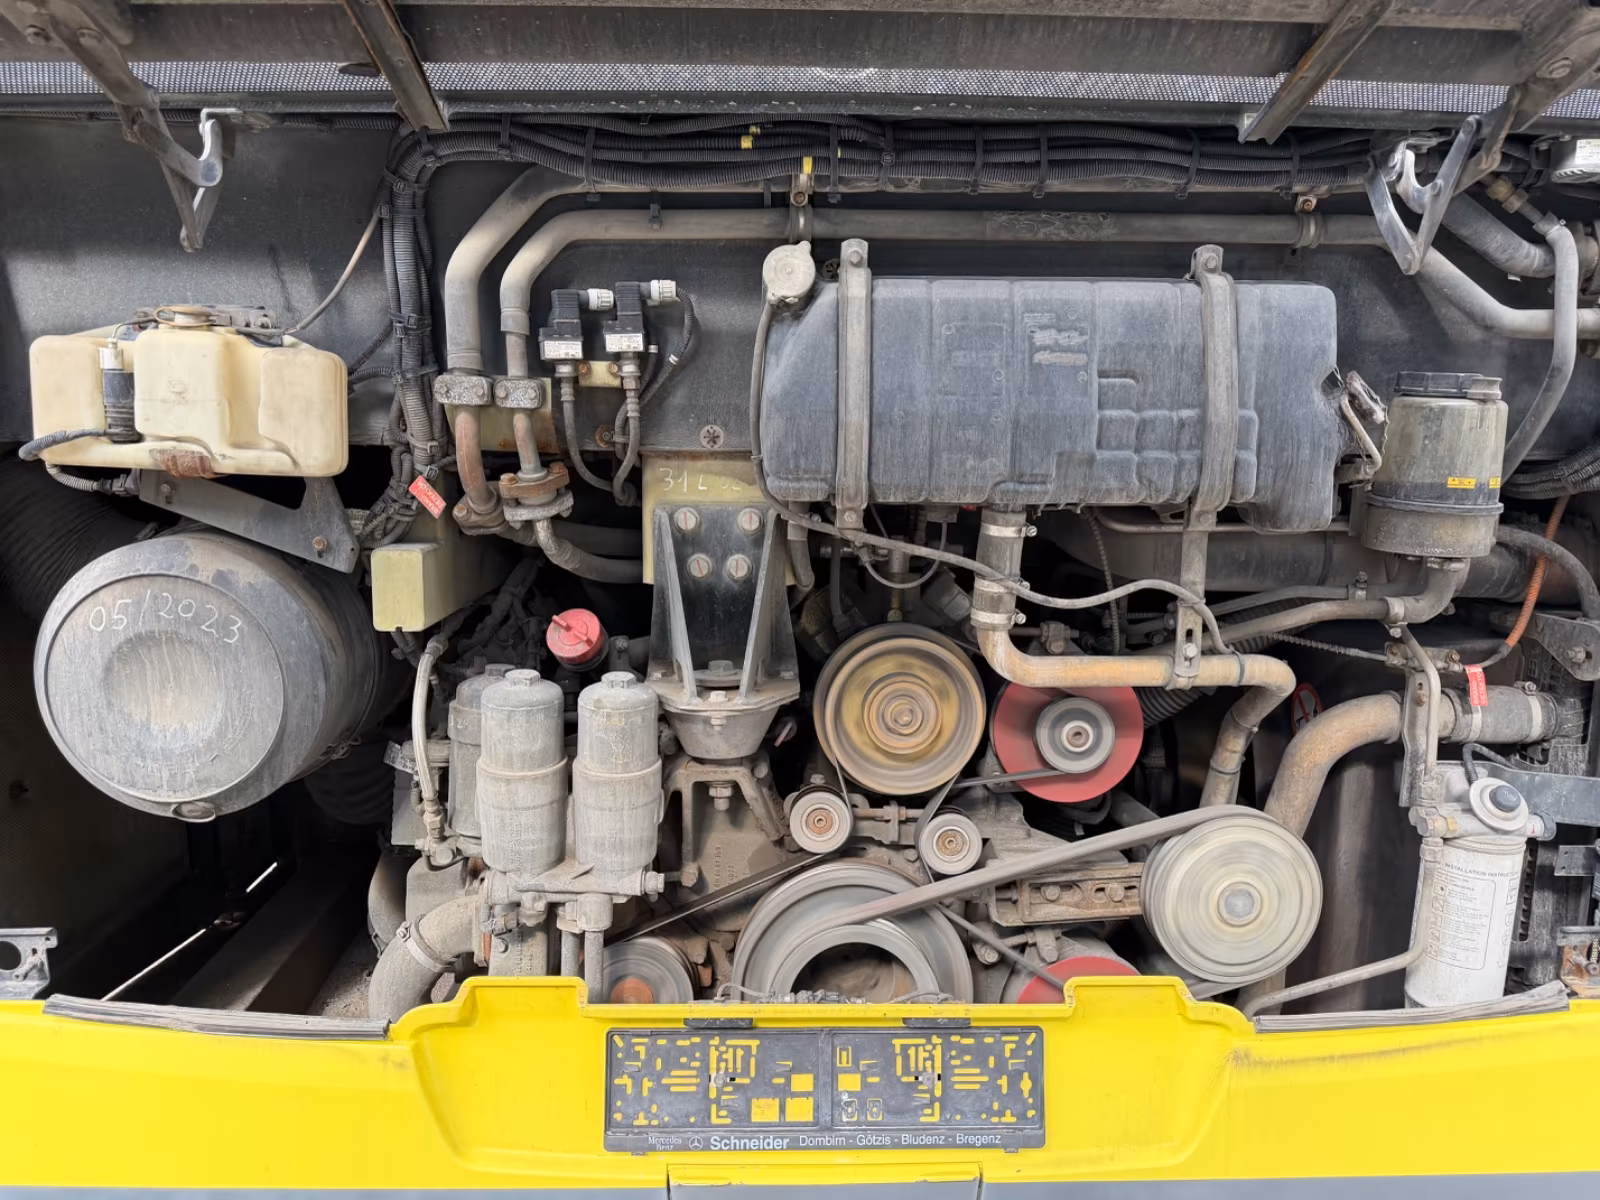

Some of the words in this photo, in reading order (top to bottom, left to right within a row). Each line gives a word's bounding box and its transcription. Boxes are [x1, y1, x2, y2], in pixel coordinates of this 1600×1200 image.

[659, 467, 688, 493] 31
[88, 588, 242, 644] 05/2023
[648, 1136, 682, 1145] Mercedes
[709, 1135, 791, 1151] Schneider
[856, 1134, 891, 1146] Götzis
[901, 1134, 946, 1145] Bludenz
[956, 1133, 1001, 1146] Bregenz
